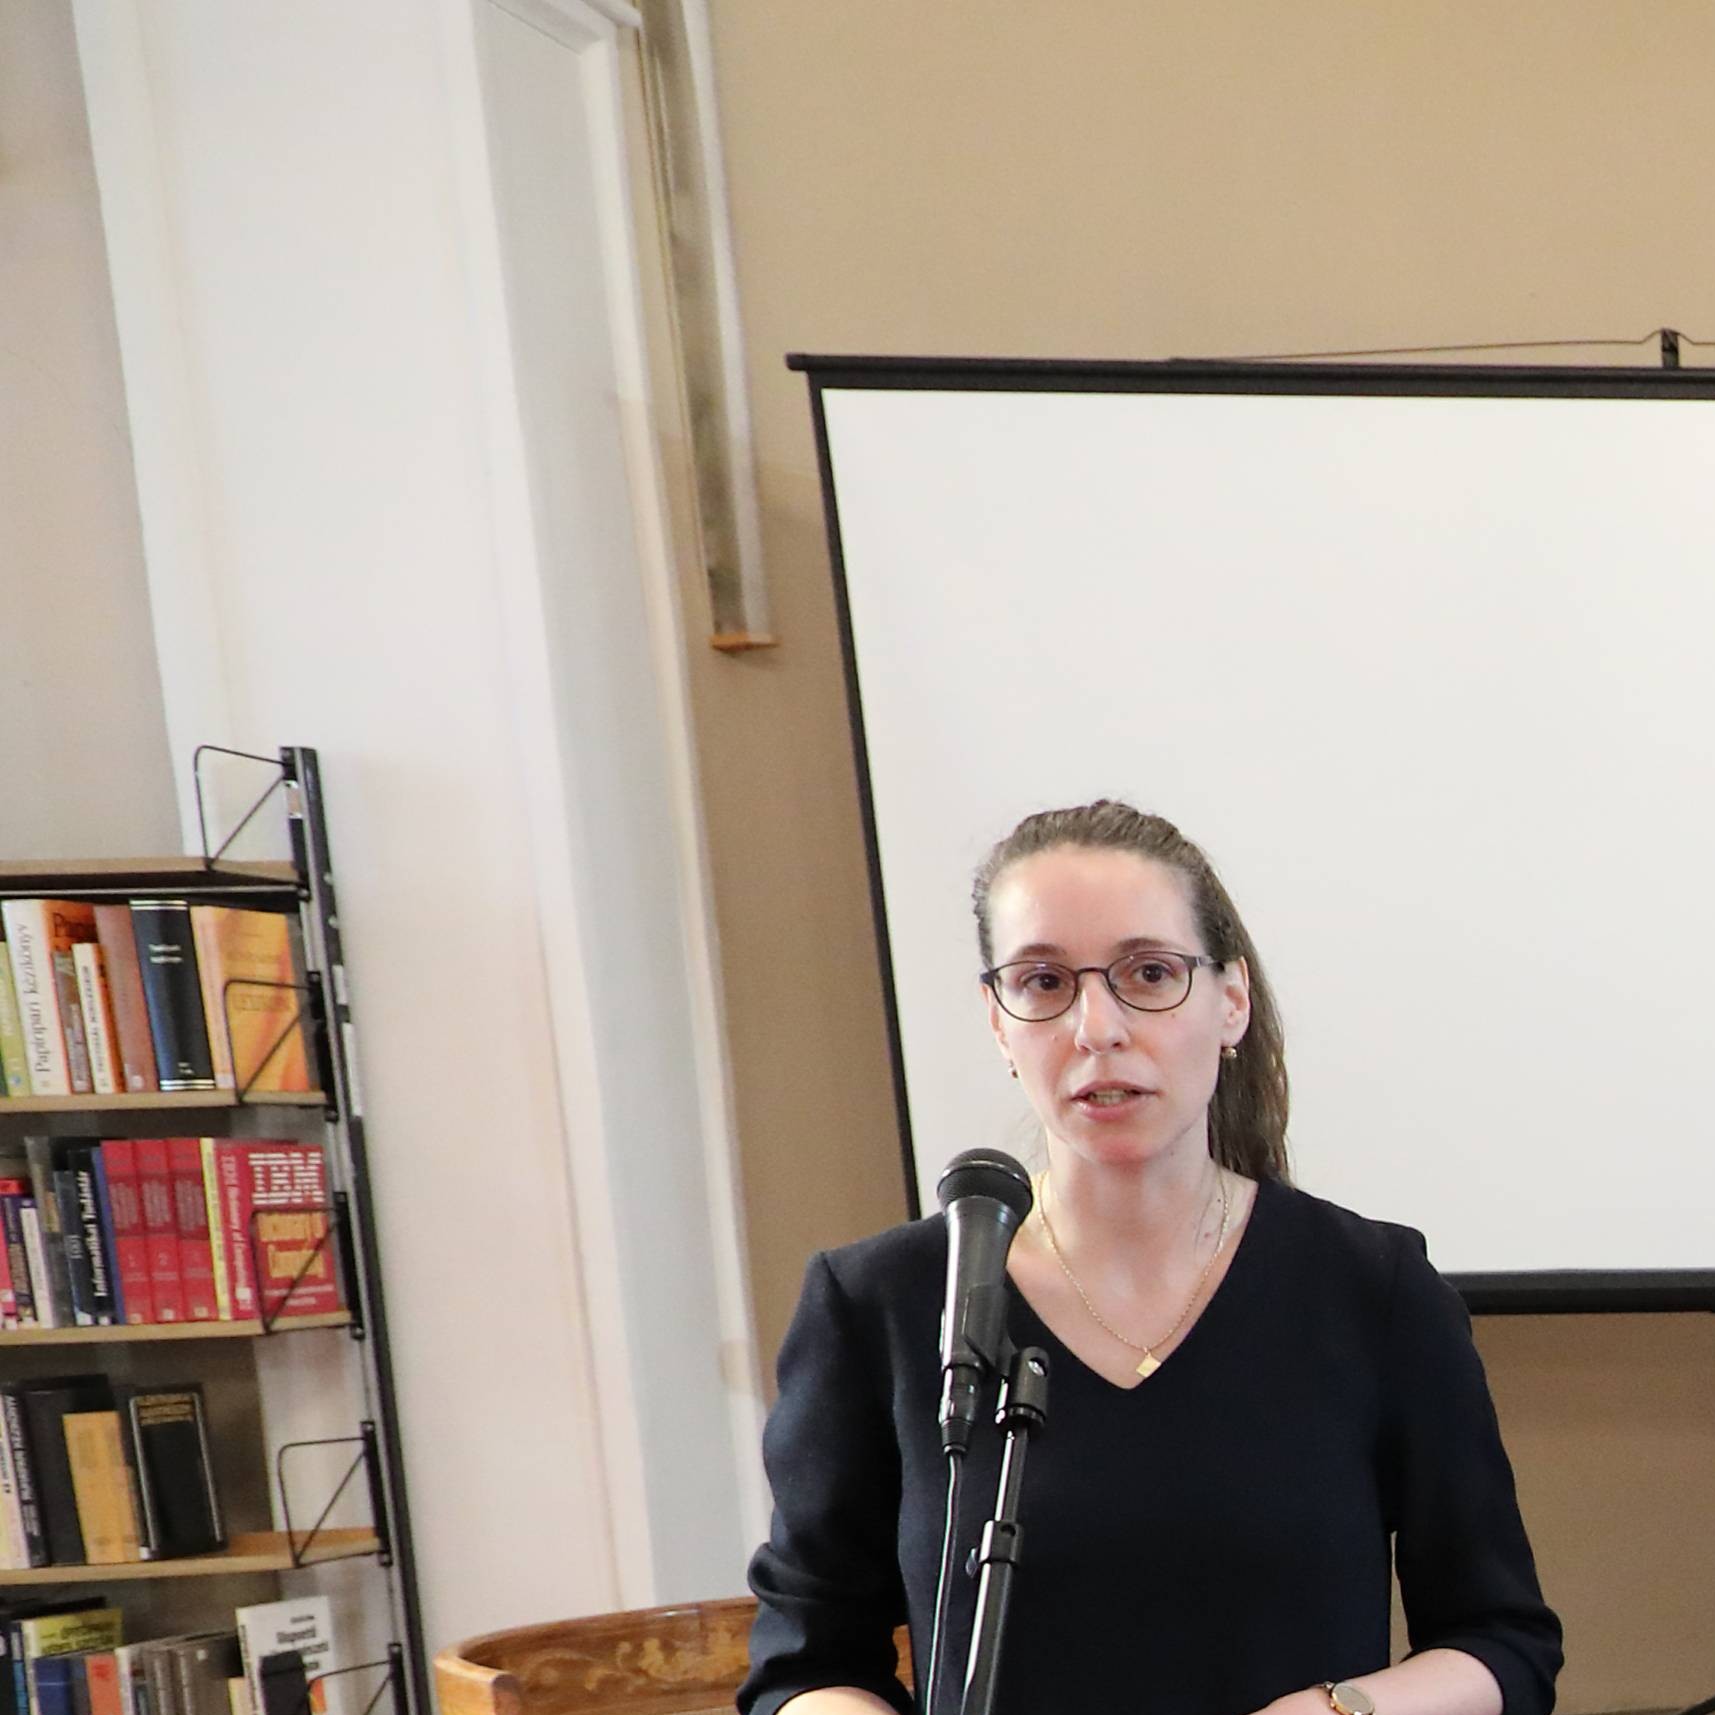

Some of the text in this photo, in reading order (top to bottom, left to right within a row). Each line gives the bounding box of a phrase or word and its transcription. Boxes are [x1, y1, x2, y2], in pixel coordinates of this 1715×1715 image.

[249, 1152, 325, 1204] IBM
[77, 1171, 107, 1297] Informatikai Tudástár
